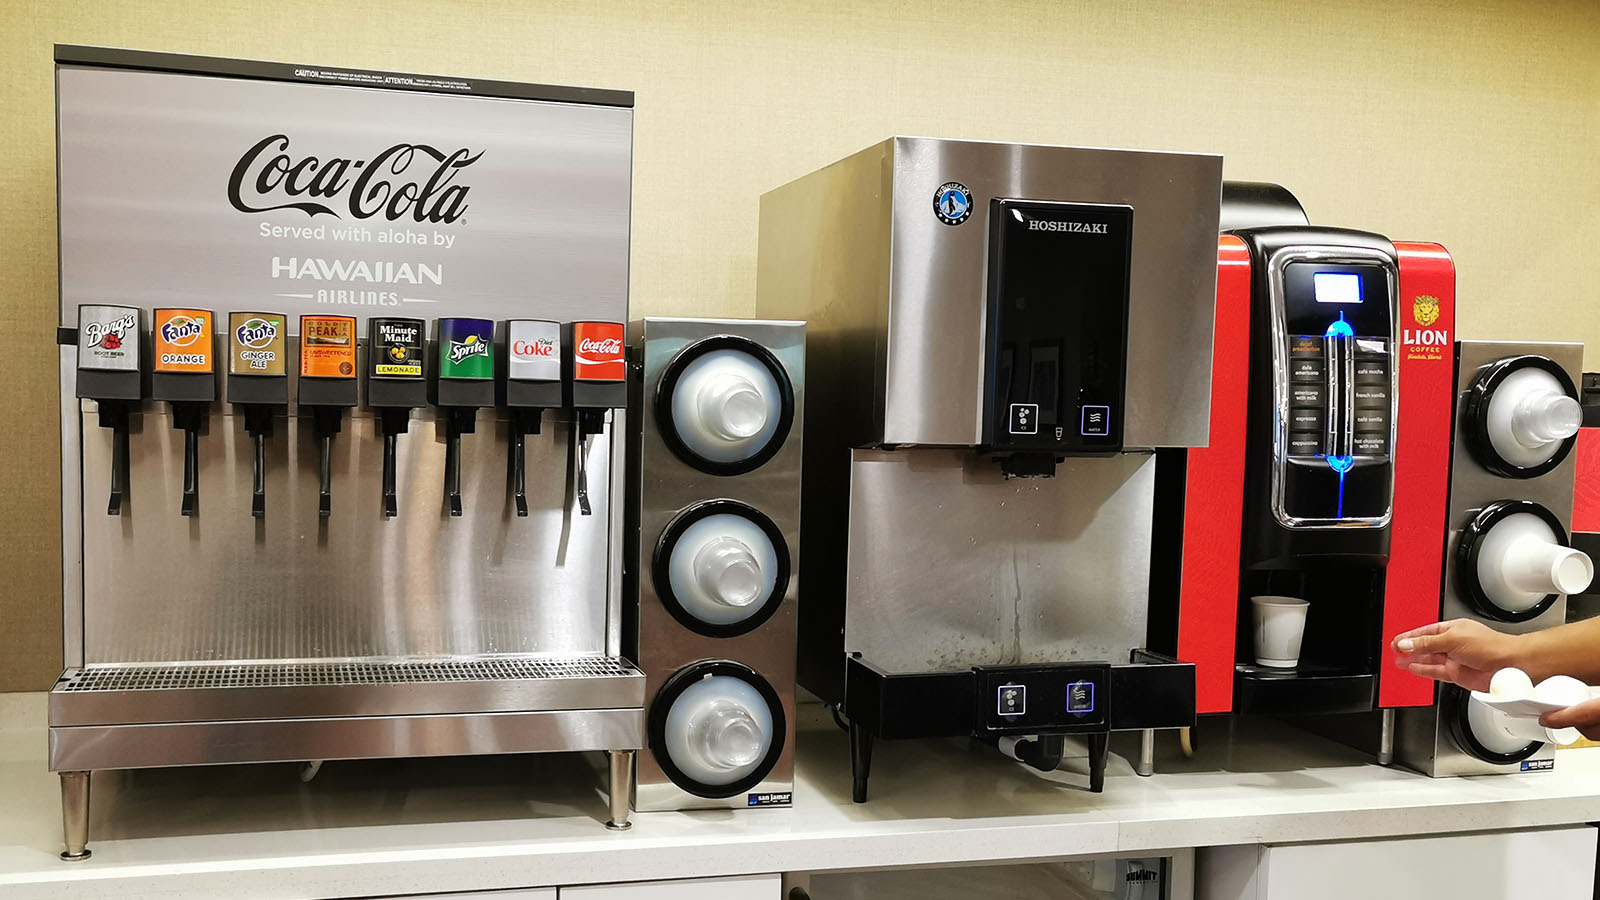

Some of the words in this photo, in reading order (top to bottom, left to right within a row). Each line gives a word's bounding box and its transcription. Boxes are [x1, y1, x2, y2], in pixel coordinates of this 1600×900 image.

[294, 69, 319, 78] CAUTION
[385, 77, 413, 86] ATTENTION
[228, 134, 486, 224] Coca-Cola
[1028, 220, 1108, 234] HOSHIZAKI
[260, 222, 325, 240] Served
[333, 226, 372, 242] with
[378, 230, 427, 245] aloha
[434, 232, 456, 248] by
[271, 256, 442, 285] HAWAIIAN
[317, 289, 400, 306] AIRLINES
[86, 314, 136, 348] Barq's
[161, 322, 202, 344] Fanta
[236, 324, 276, 346] Fanta
[309, 327, 338, 336] PEAK
[380, 325, 418, 335] Minute
[1403, 329, 1448, 346] LION
[384, 334, 412, 342] Maid
[241, 351, 275, 360] GINGER
[450, 341, 485, 360] Sprite
[513, 340, 552, 356] Coke
[162, 354, 205, 364] ORANGE
[250, 360, 267, 369] ALE
[1126, 869, 1157, 881] SUMMIT
